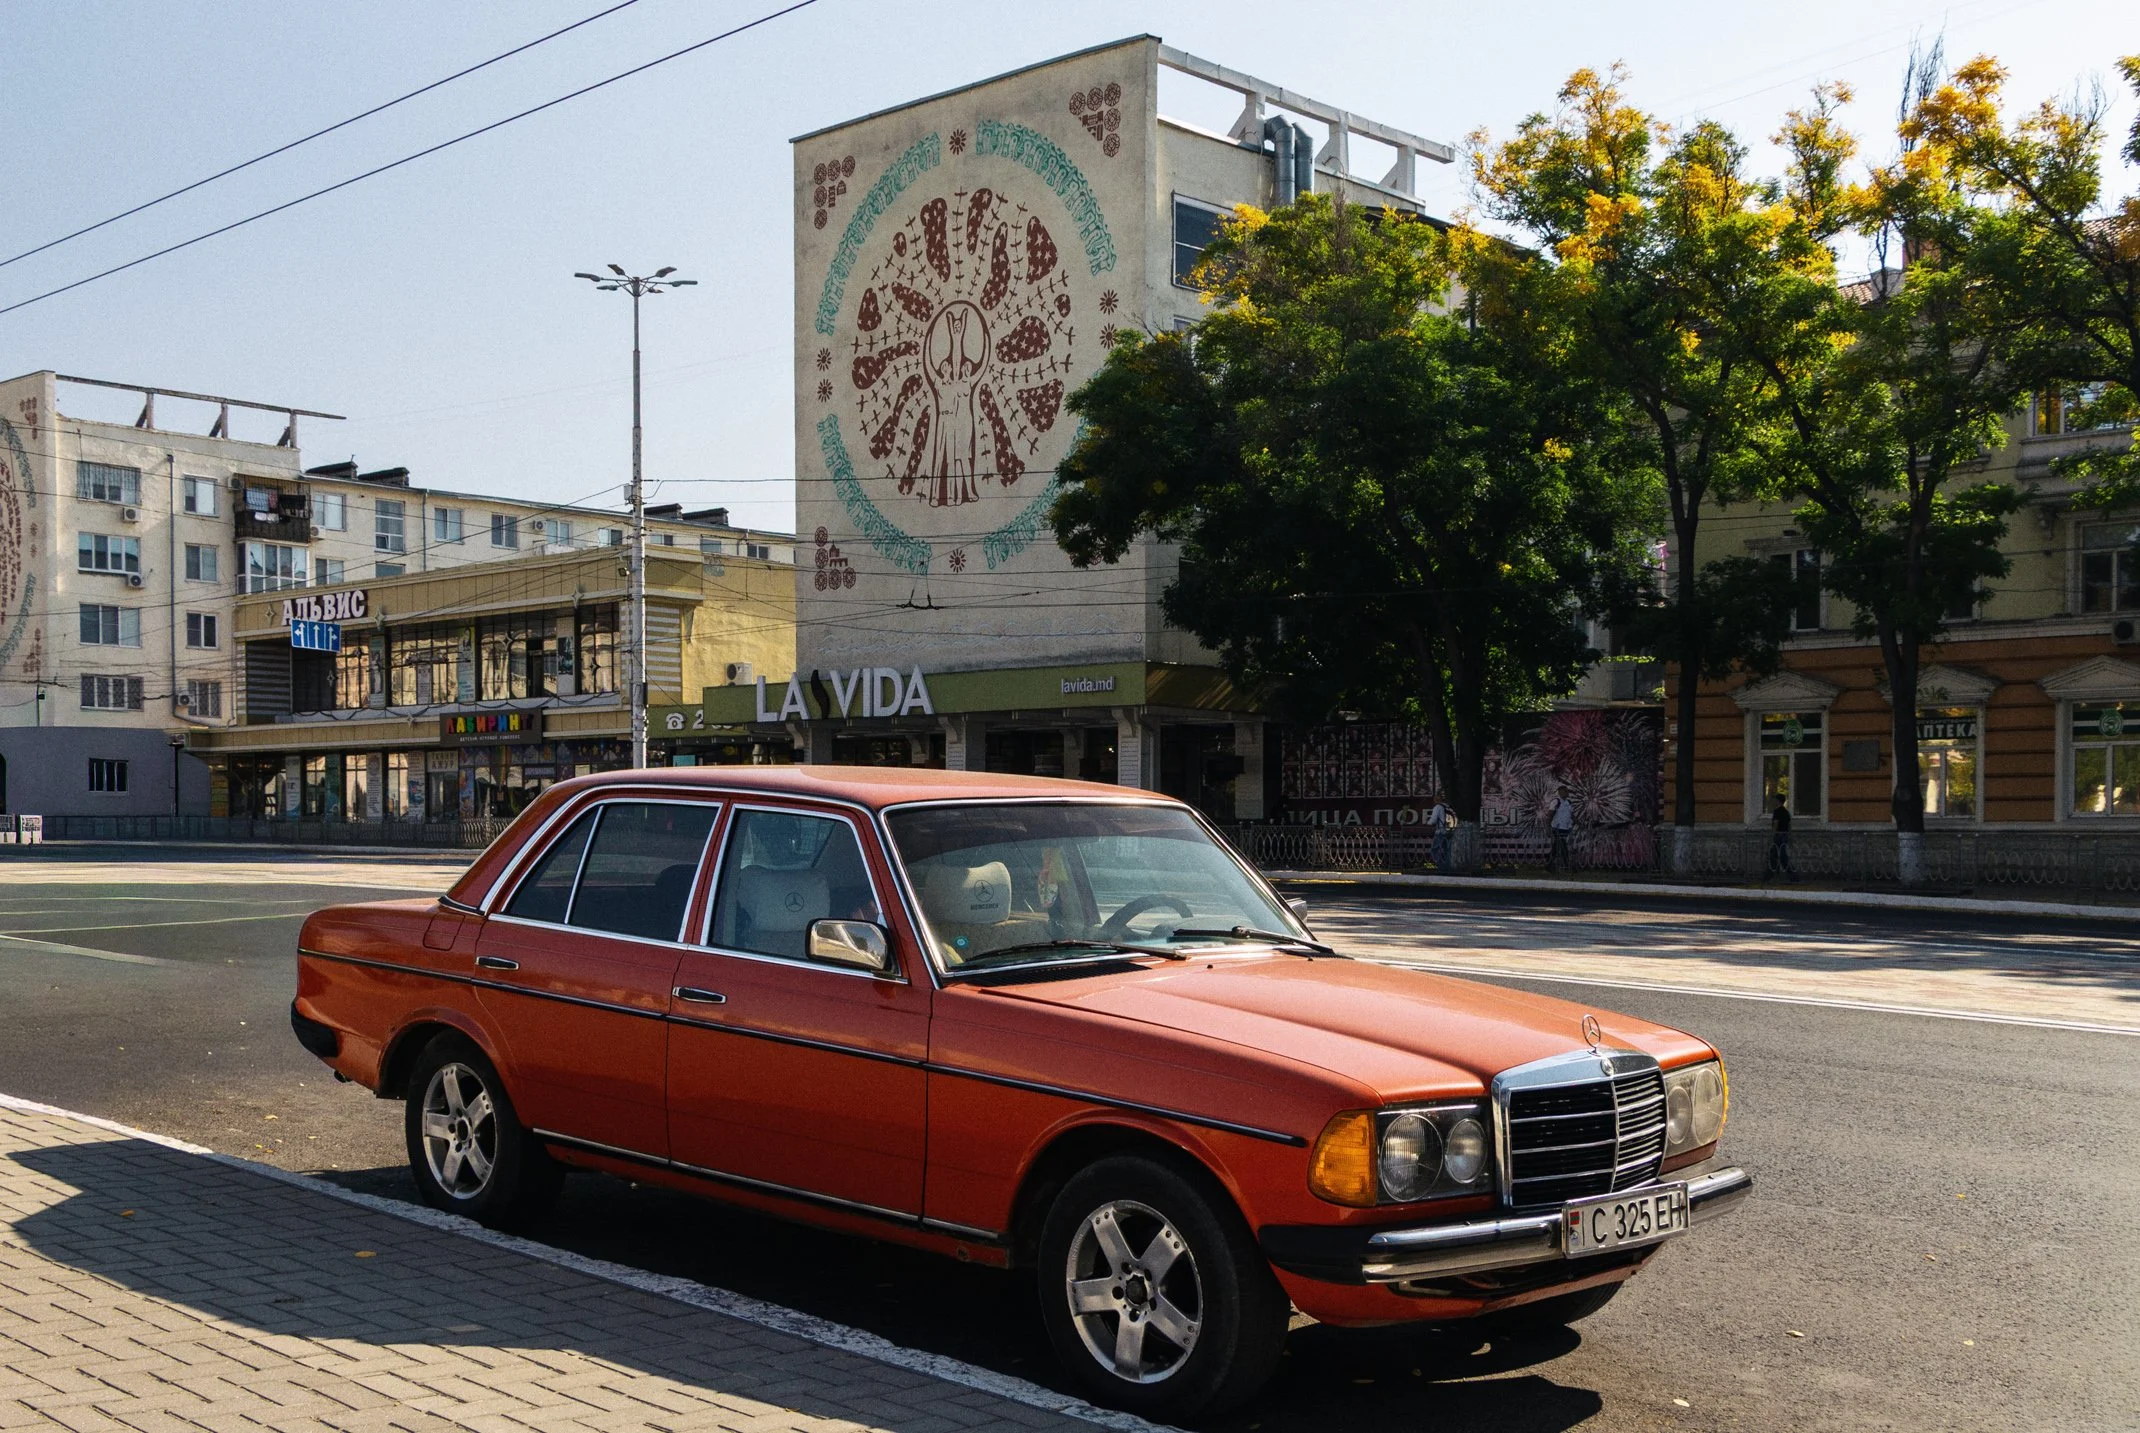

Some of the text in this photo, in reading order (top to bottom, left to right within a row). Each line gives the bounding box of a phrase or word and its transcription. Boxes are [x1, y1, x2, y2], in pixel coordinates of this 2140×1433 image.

[281, 590, 366, 626] АЛЬВИС
[756, 664, 936, 722] LA VIDA
[1061, 676, 1114, 694] lavida.md
[1374, 808, 1518, 832] ПОЫ
[1592, 1192, 1682, 1244] C 325 EH
